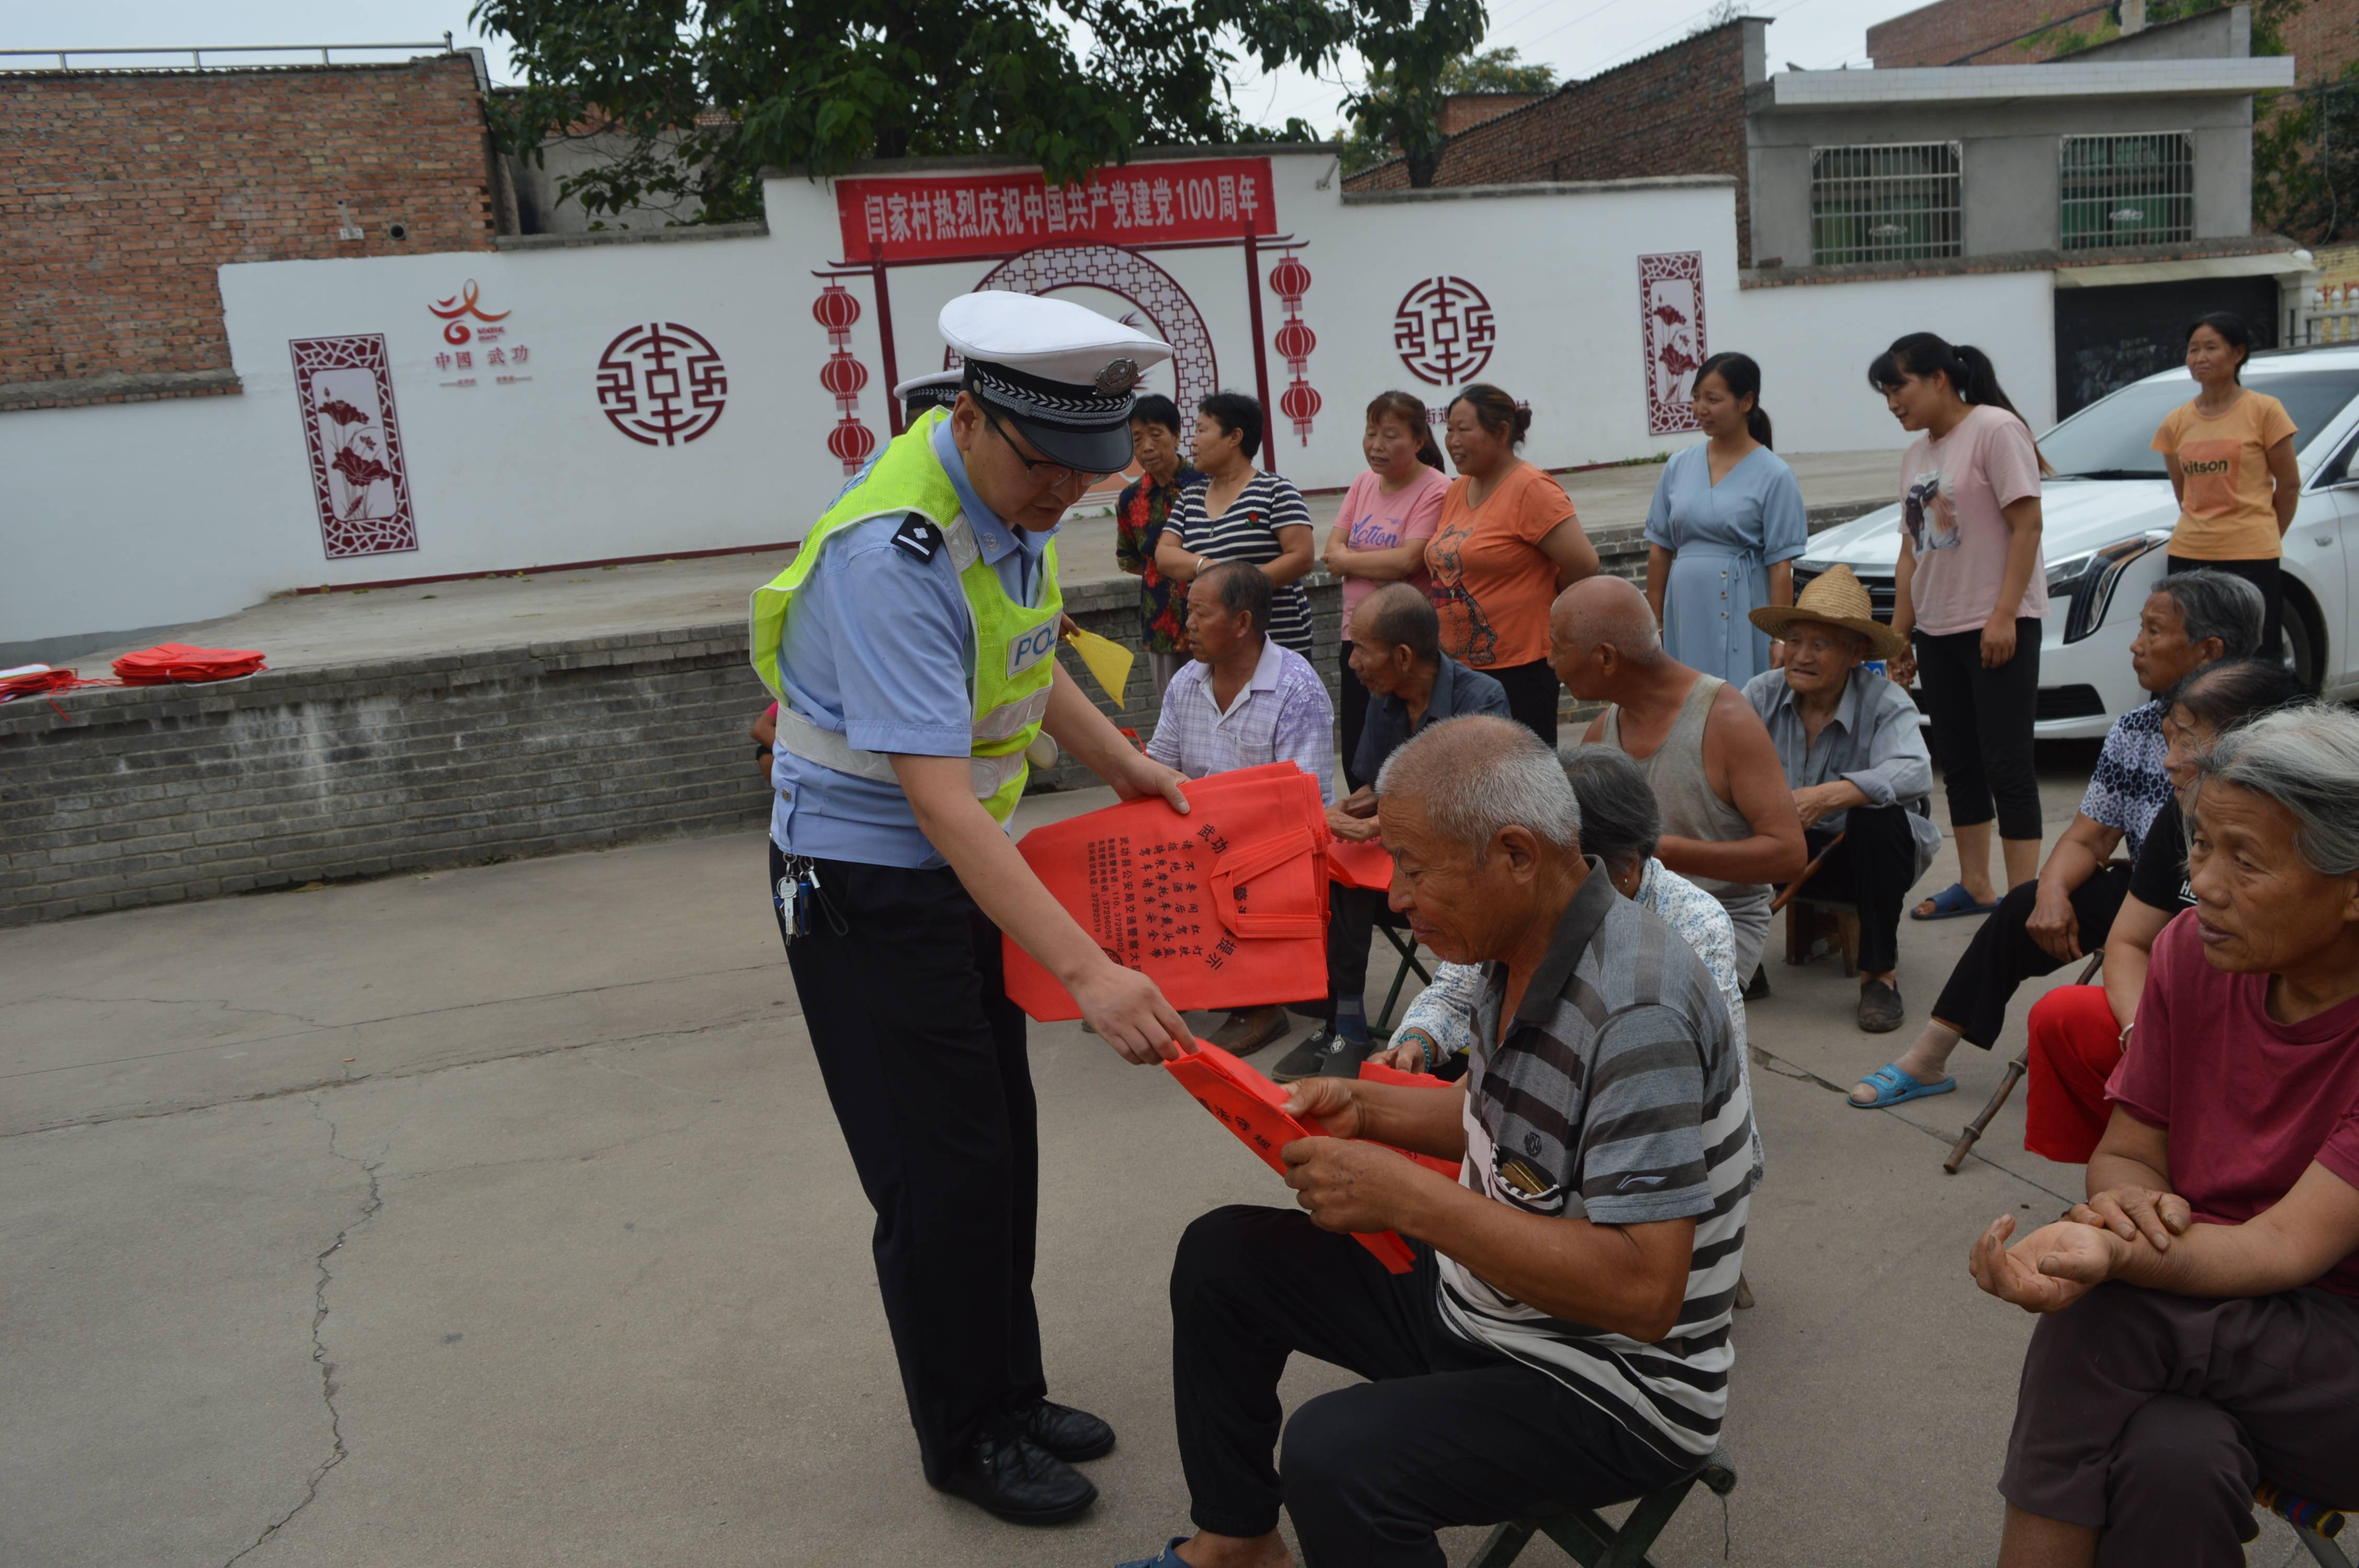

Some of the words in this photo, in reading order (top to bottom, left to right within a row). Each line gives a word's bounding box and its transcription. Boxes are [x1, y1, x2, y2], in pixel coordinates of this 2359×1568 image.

[865, 174, 1258, 243] 闫家村热烈庆祝中国共产党建党100周年
[2183, 459, 2228, 474] kitson
[1349, 514, 1401, 548] Action
